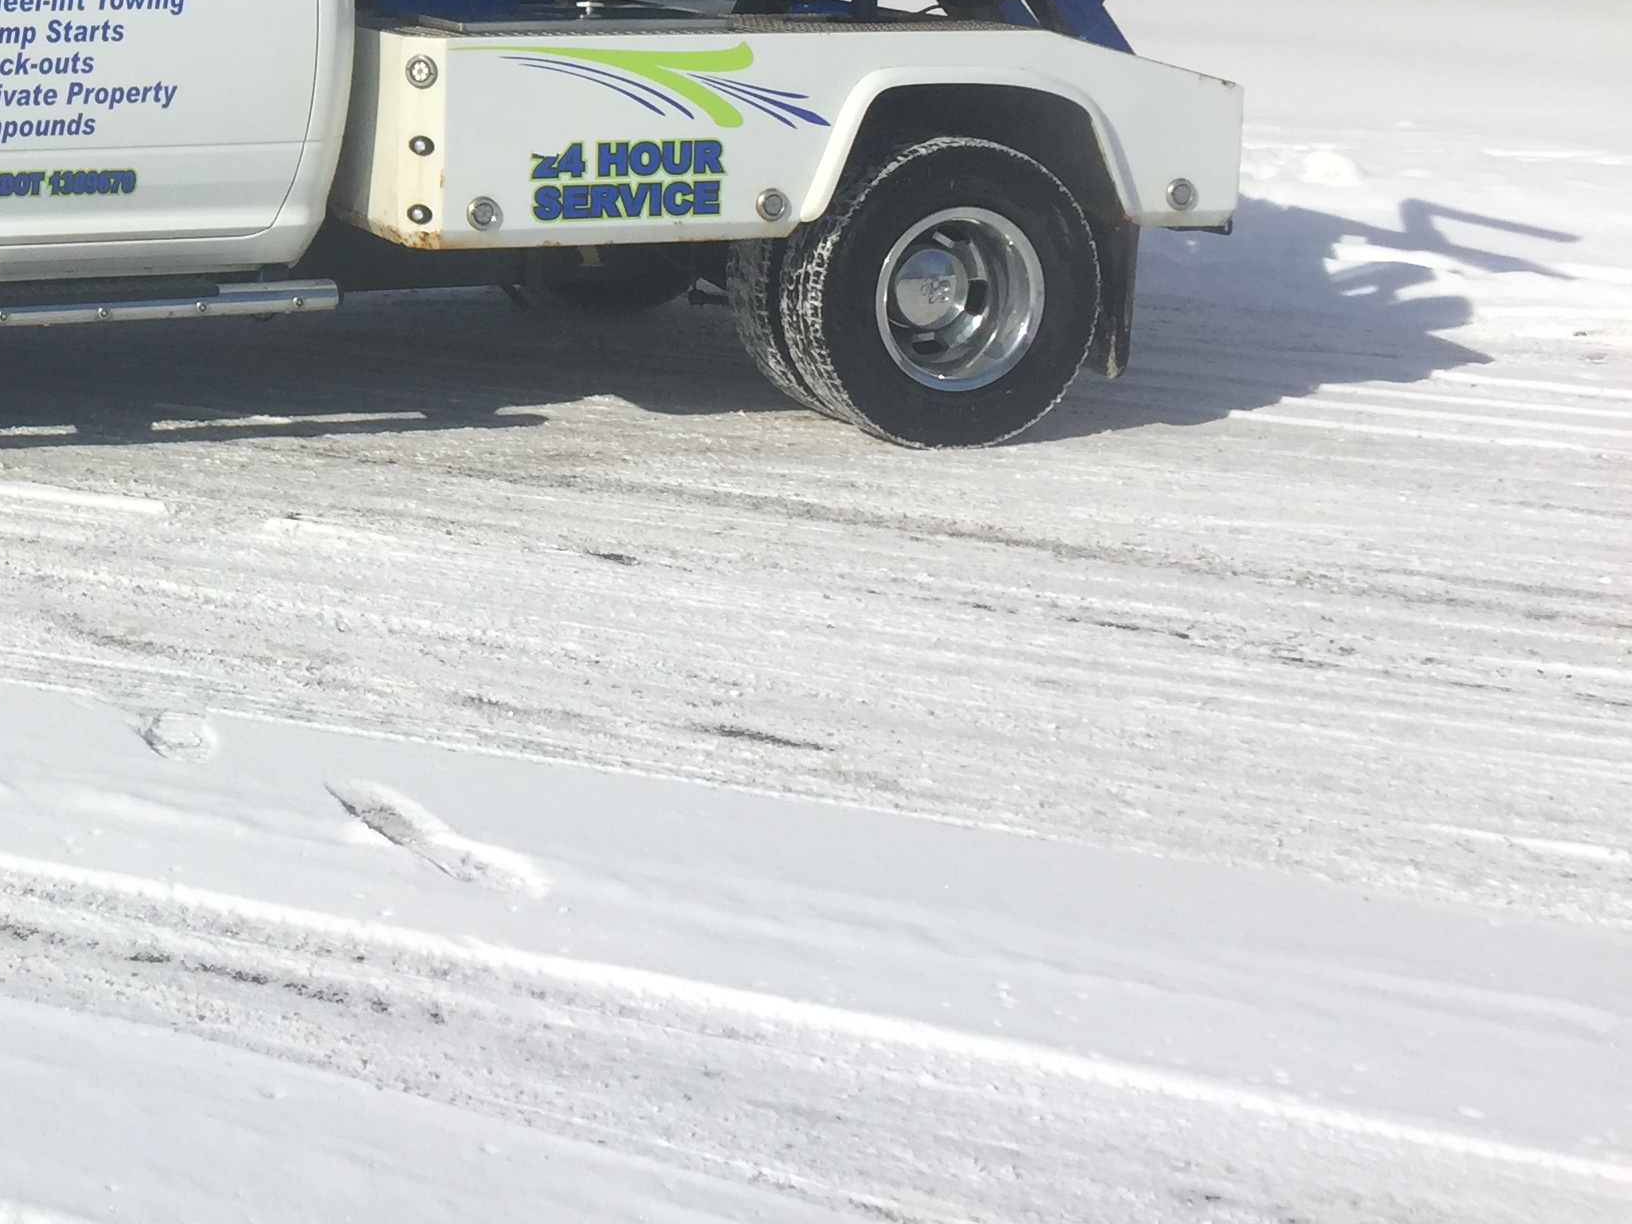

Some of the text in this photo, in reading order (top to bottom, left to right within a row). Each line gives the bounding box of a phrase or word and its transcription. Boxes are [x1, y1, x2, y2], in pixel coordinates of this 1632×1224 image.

[46, 19, 124, 44] Starts
[66, 81, 178, 110] Property
[596, 139, 726, 177] HOUR
[532, 178, 721, 222] SERVICE
